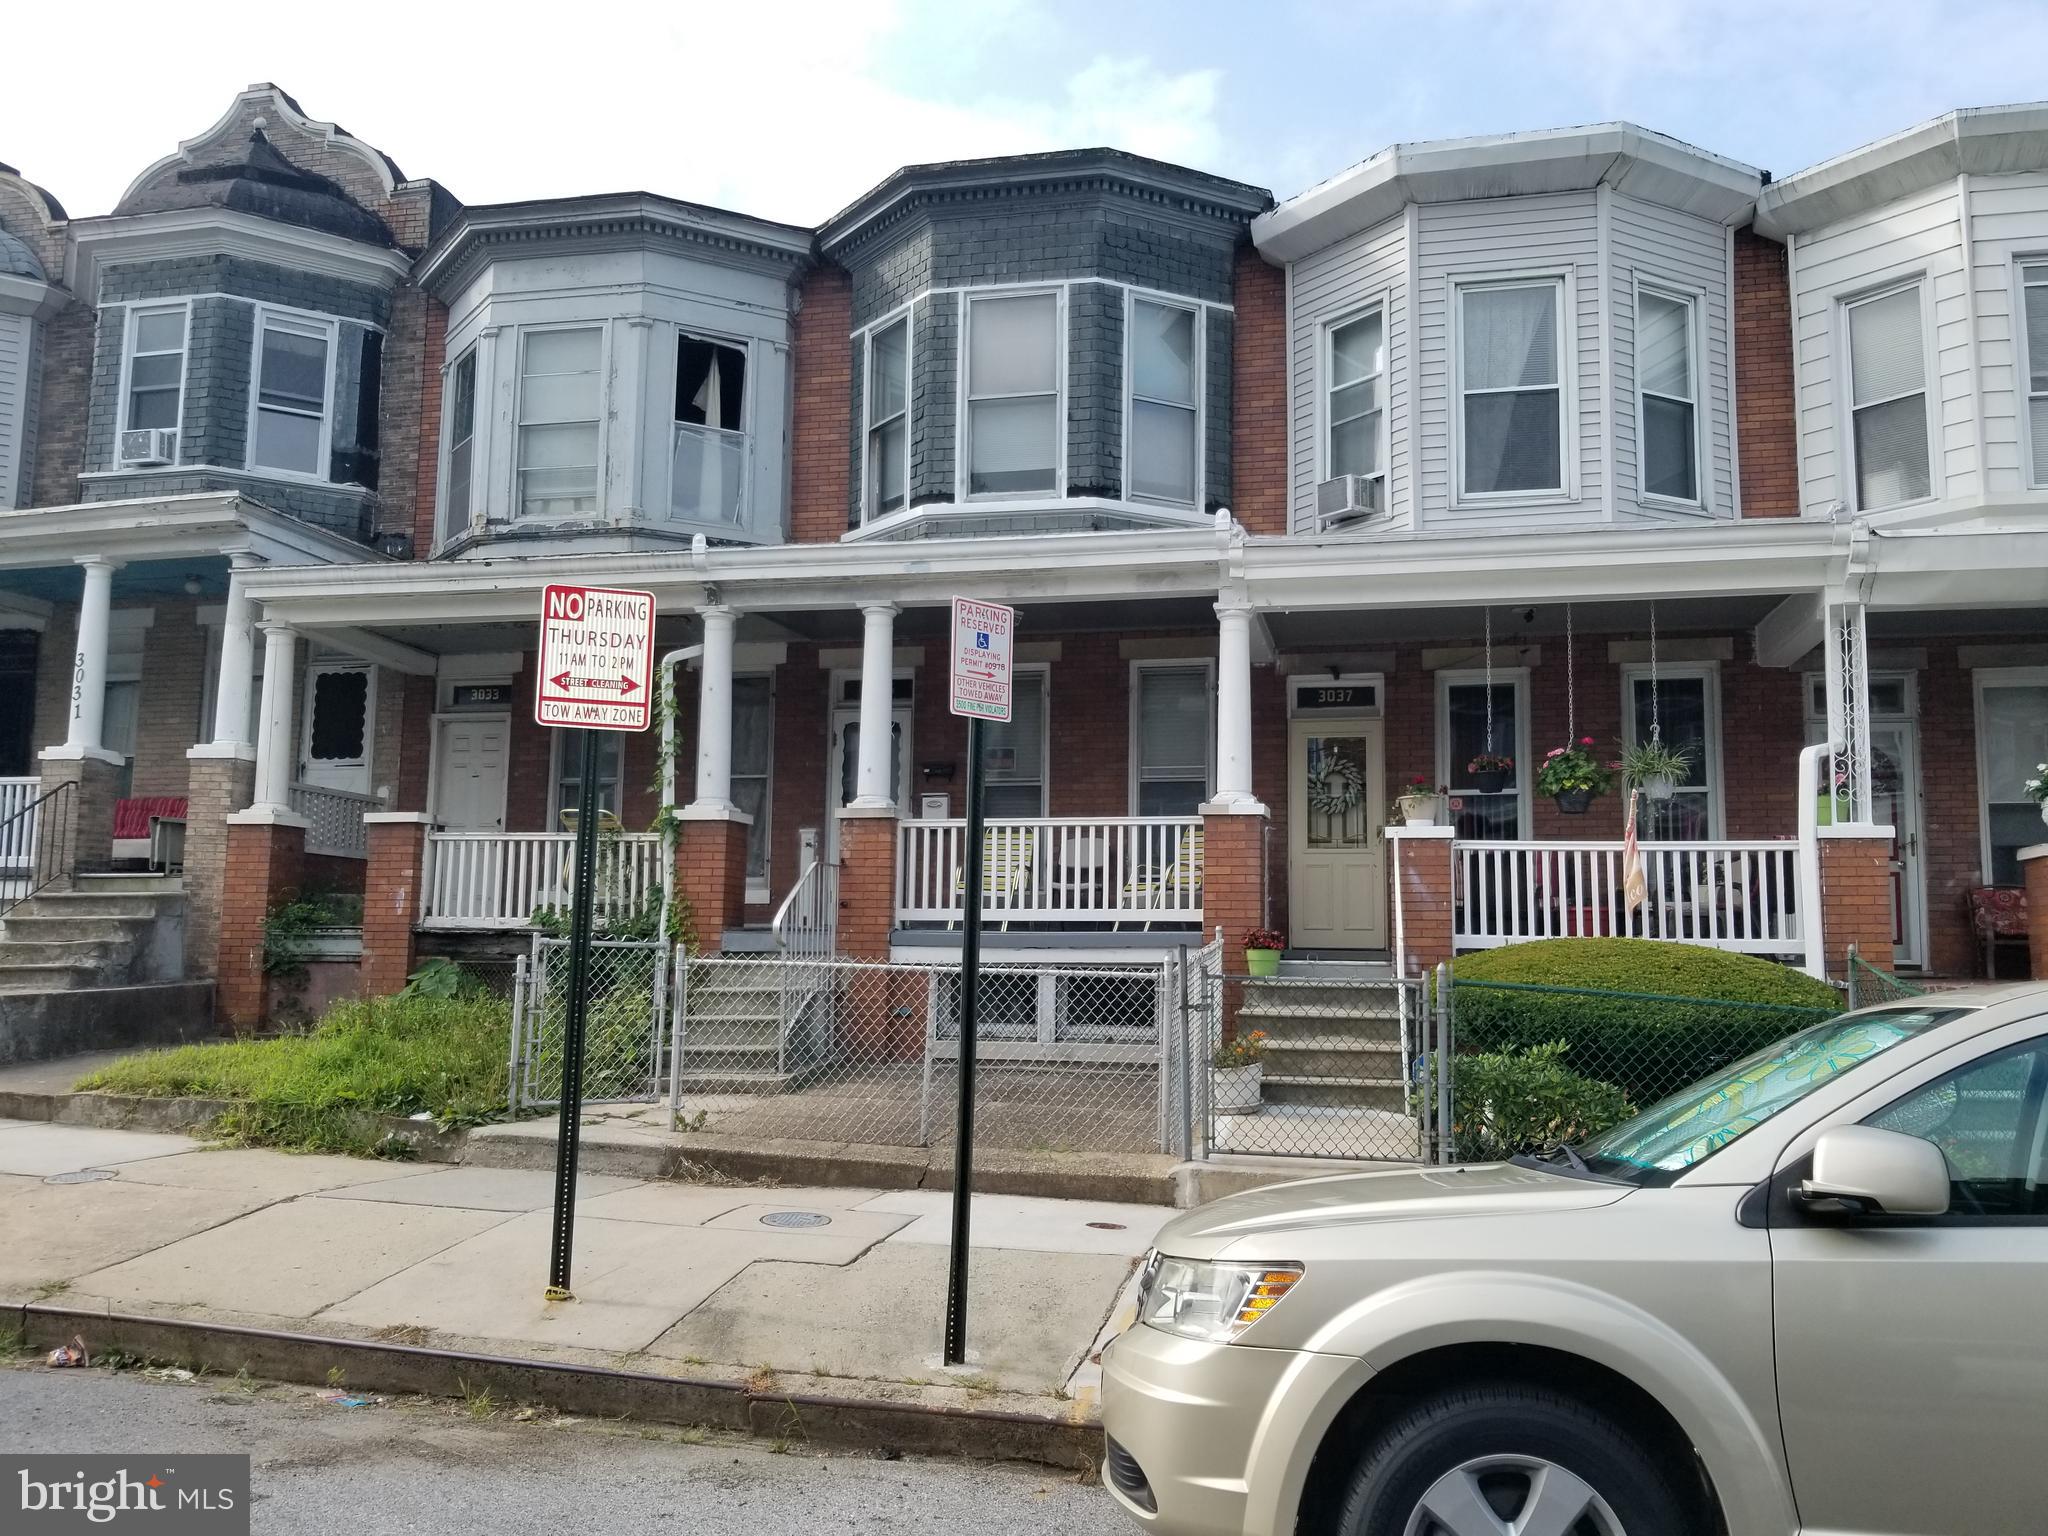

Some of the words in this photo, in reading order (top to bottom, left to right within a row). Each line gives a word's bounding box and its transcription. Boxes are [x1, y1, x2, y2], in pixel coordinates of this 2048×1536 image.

[550, 592, 583, 619] NO
[588, 598, 647, 620] PARKING
[960, 603, 1007, 623] PARKING
[961, 617, 1005, 635] RESERVED
[549, 628, 645, 650] THURSDAY
[560, 652, 568, 665] 11
[571, 653, 586, 666] AM
[592, 655, 606, 668] TO
[612, 657, 617, 669] 2
[620, 657, 634, 670] PM
[960, 657, 982, 669] PERMIT
[964, 648, 1000, 661] DISPLAYING
[72, 652, 85, 719] 3031
[561, 677, 588, 687] STREET
[592, 679, 629, 689] CLEANING
[956, 677, 977, 689] OTHER
[978, 681, 1006, 693] VEHICLES
[471, 689, 499, 700] 3033
[960, 687, 982, 699] TOWED
[984, 691, 1003, 702] AWAY
[1318, 689, 1353, 702] 3037
[544, 704, 570, 718] TOW
[575, 706, 608, 720] AWAY
[613, 708, 642, 723] ZONE
